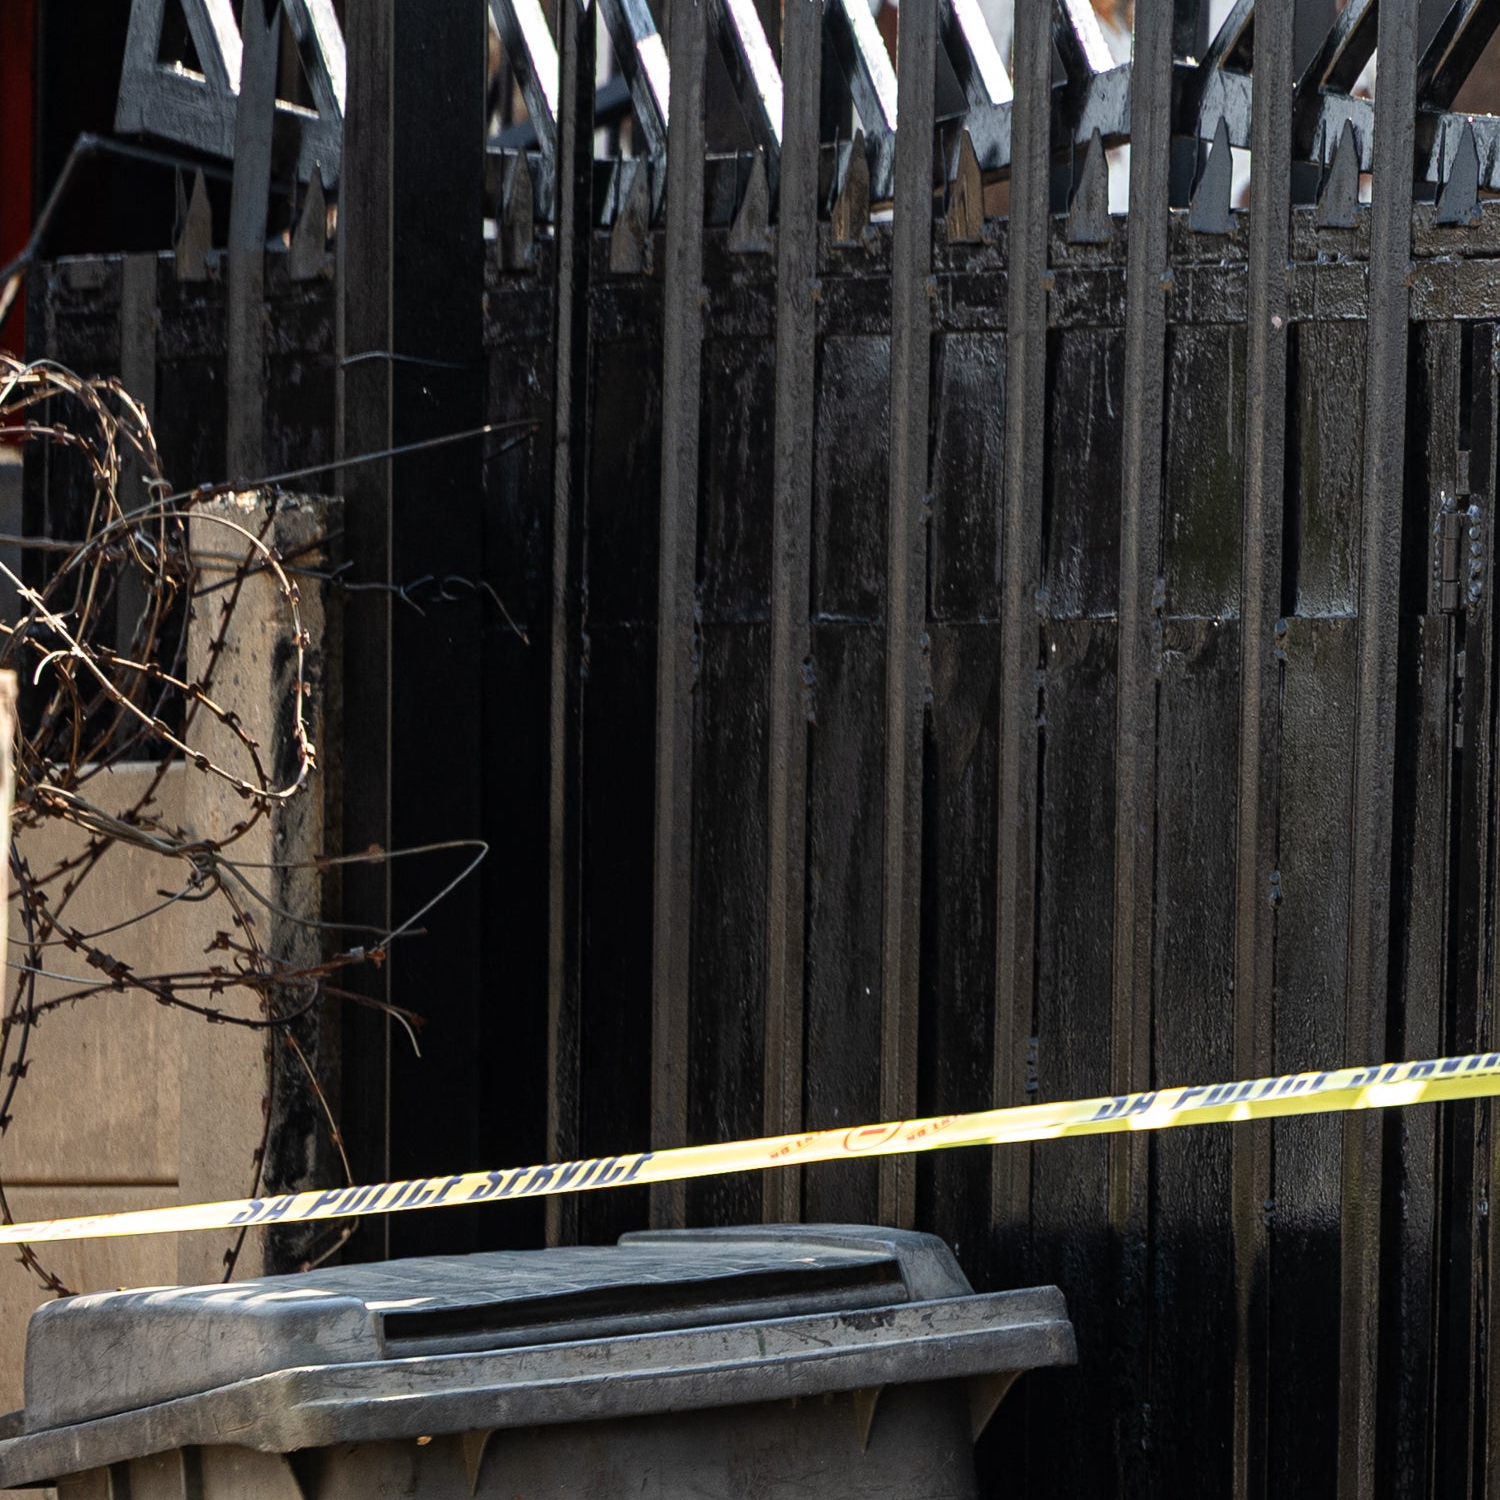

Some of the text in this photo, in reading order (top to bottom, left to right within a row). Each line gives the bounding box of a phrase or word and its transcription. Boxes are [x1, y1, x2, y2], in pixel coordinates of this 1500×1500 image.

[228, 1152, 656, 1225] SA POLICE SERVICE
